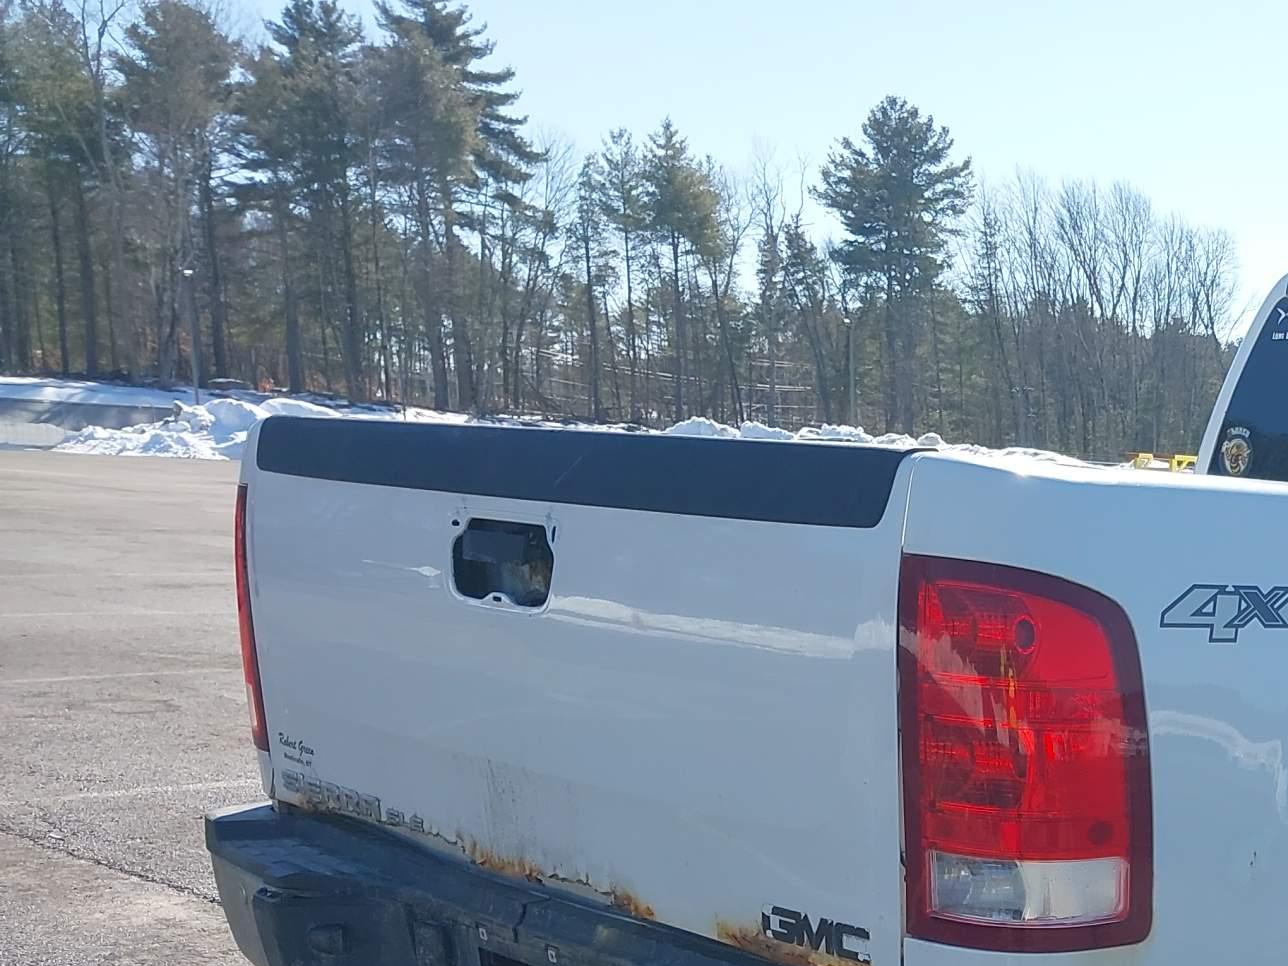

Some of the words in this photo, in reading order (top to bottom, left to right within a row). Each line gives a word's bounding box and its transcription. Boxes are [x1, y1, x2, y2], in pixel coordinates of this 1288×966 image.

[278, 732, 297, 750] Robert
[298, 740, 314, 757] Green
[281, 768, 382, 823] SIERRA
[385, 808, 425, 833] SLE
[762, 904, 872, 966] GMC
